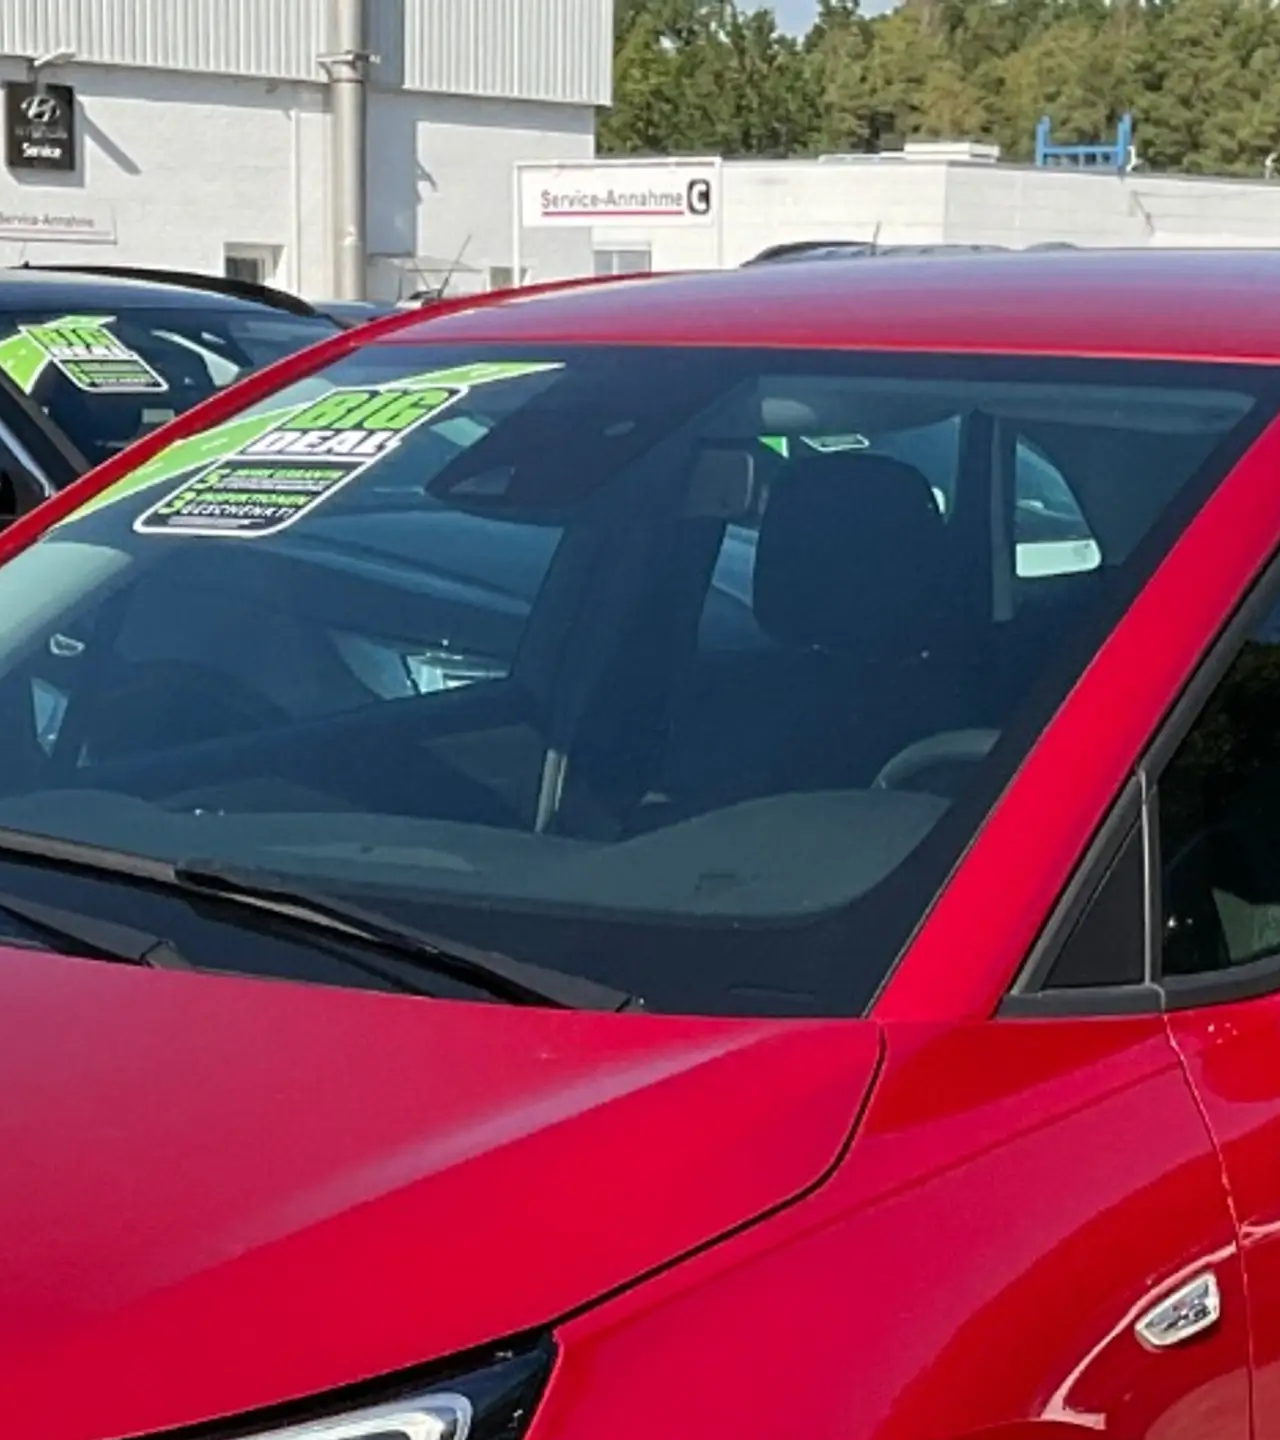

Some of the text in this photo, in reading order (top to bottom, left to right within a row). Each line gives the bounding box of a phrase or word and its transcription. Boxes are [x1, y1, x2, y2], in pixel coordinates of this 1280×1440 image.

[22, 141, 63, 159] Service
[541, 189, 684, 210] Service-Annahme
[27, 327, 112, 346] BIG
[284, 388, 452, 430] BIG
[244, 430, 398, 454] DEAL
